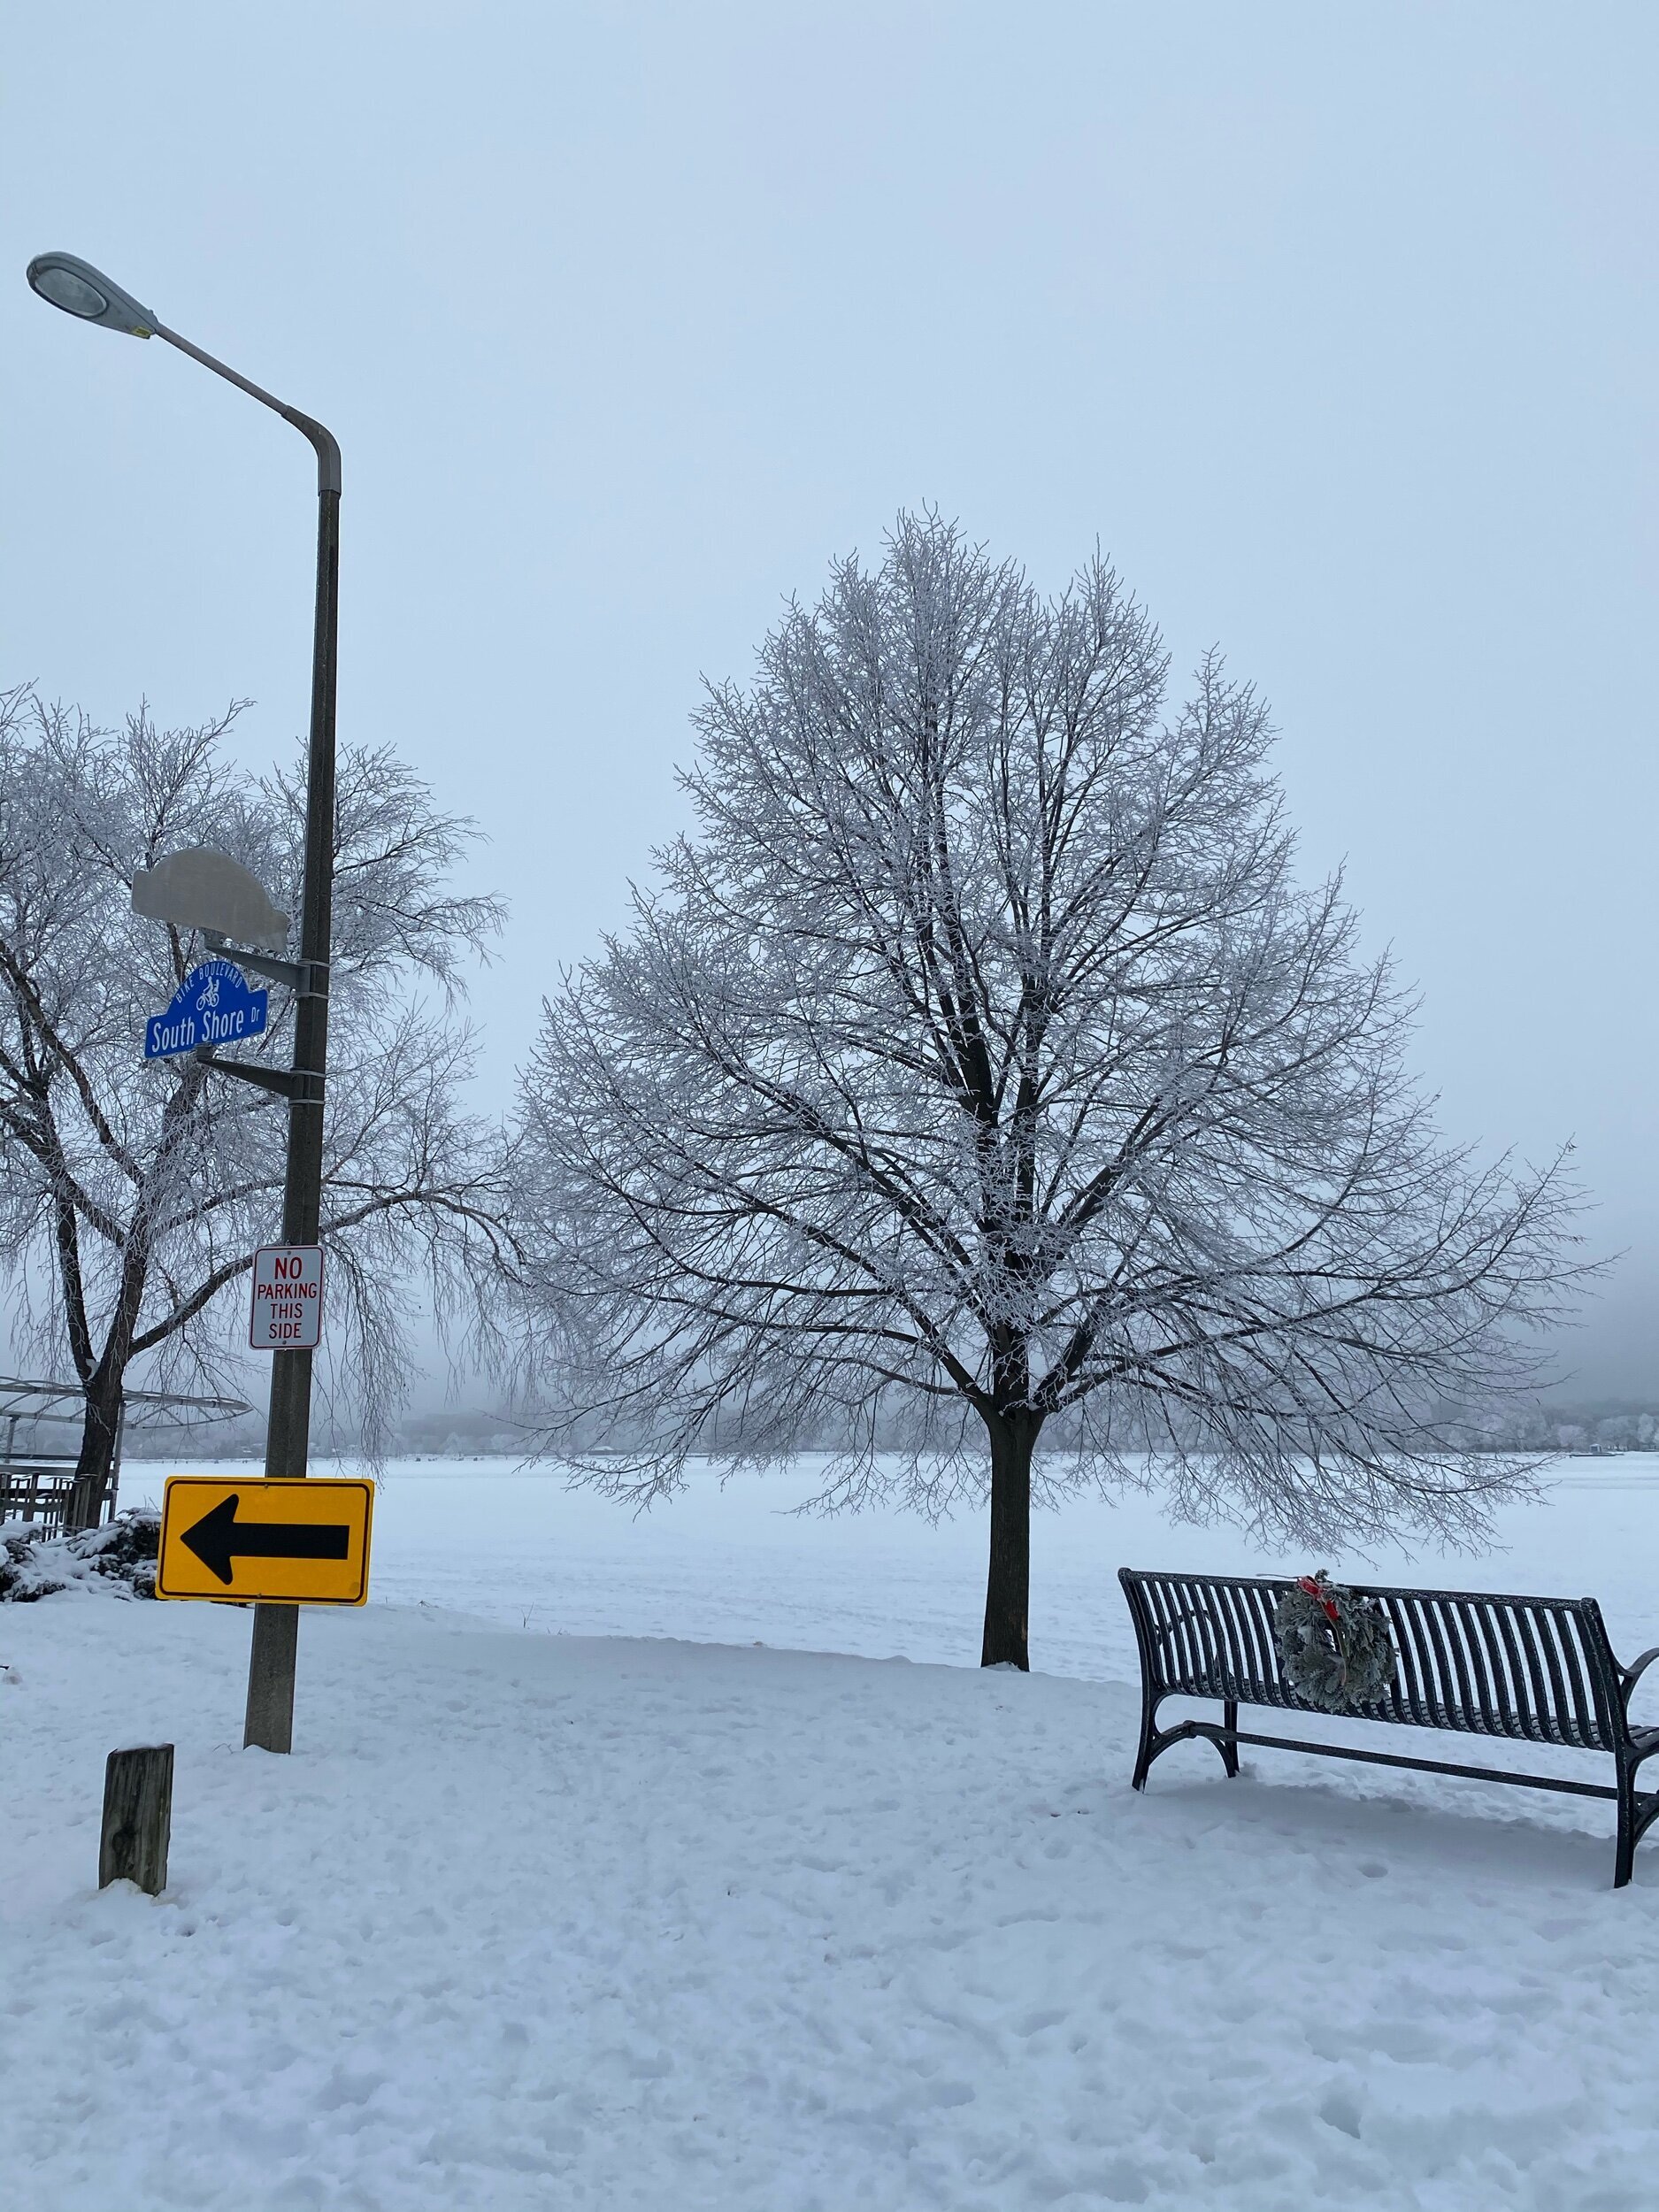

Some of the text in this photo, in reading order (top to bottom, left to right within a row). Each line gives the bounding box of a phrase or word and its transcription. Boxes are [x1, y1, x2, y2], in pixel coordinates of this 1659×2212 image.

[176, 963, 243, 1003] BIKE BOULEVARD
[151, 1007, 260, 1053] South Shore Dr
[274, 1256, 303, 1279] NO
[257, 1283, 317, 1300] PARKING
[270, 1302, 303, 1319] THIS
[268, 1323, 302, 1339] SIDE
